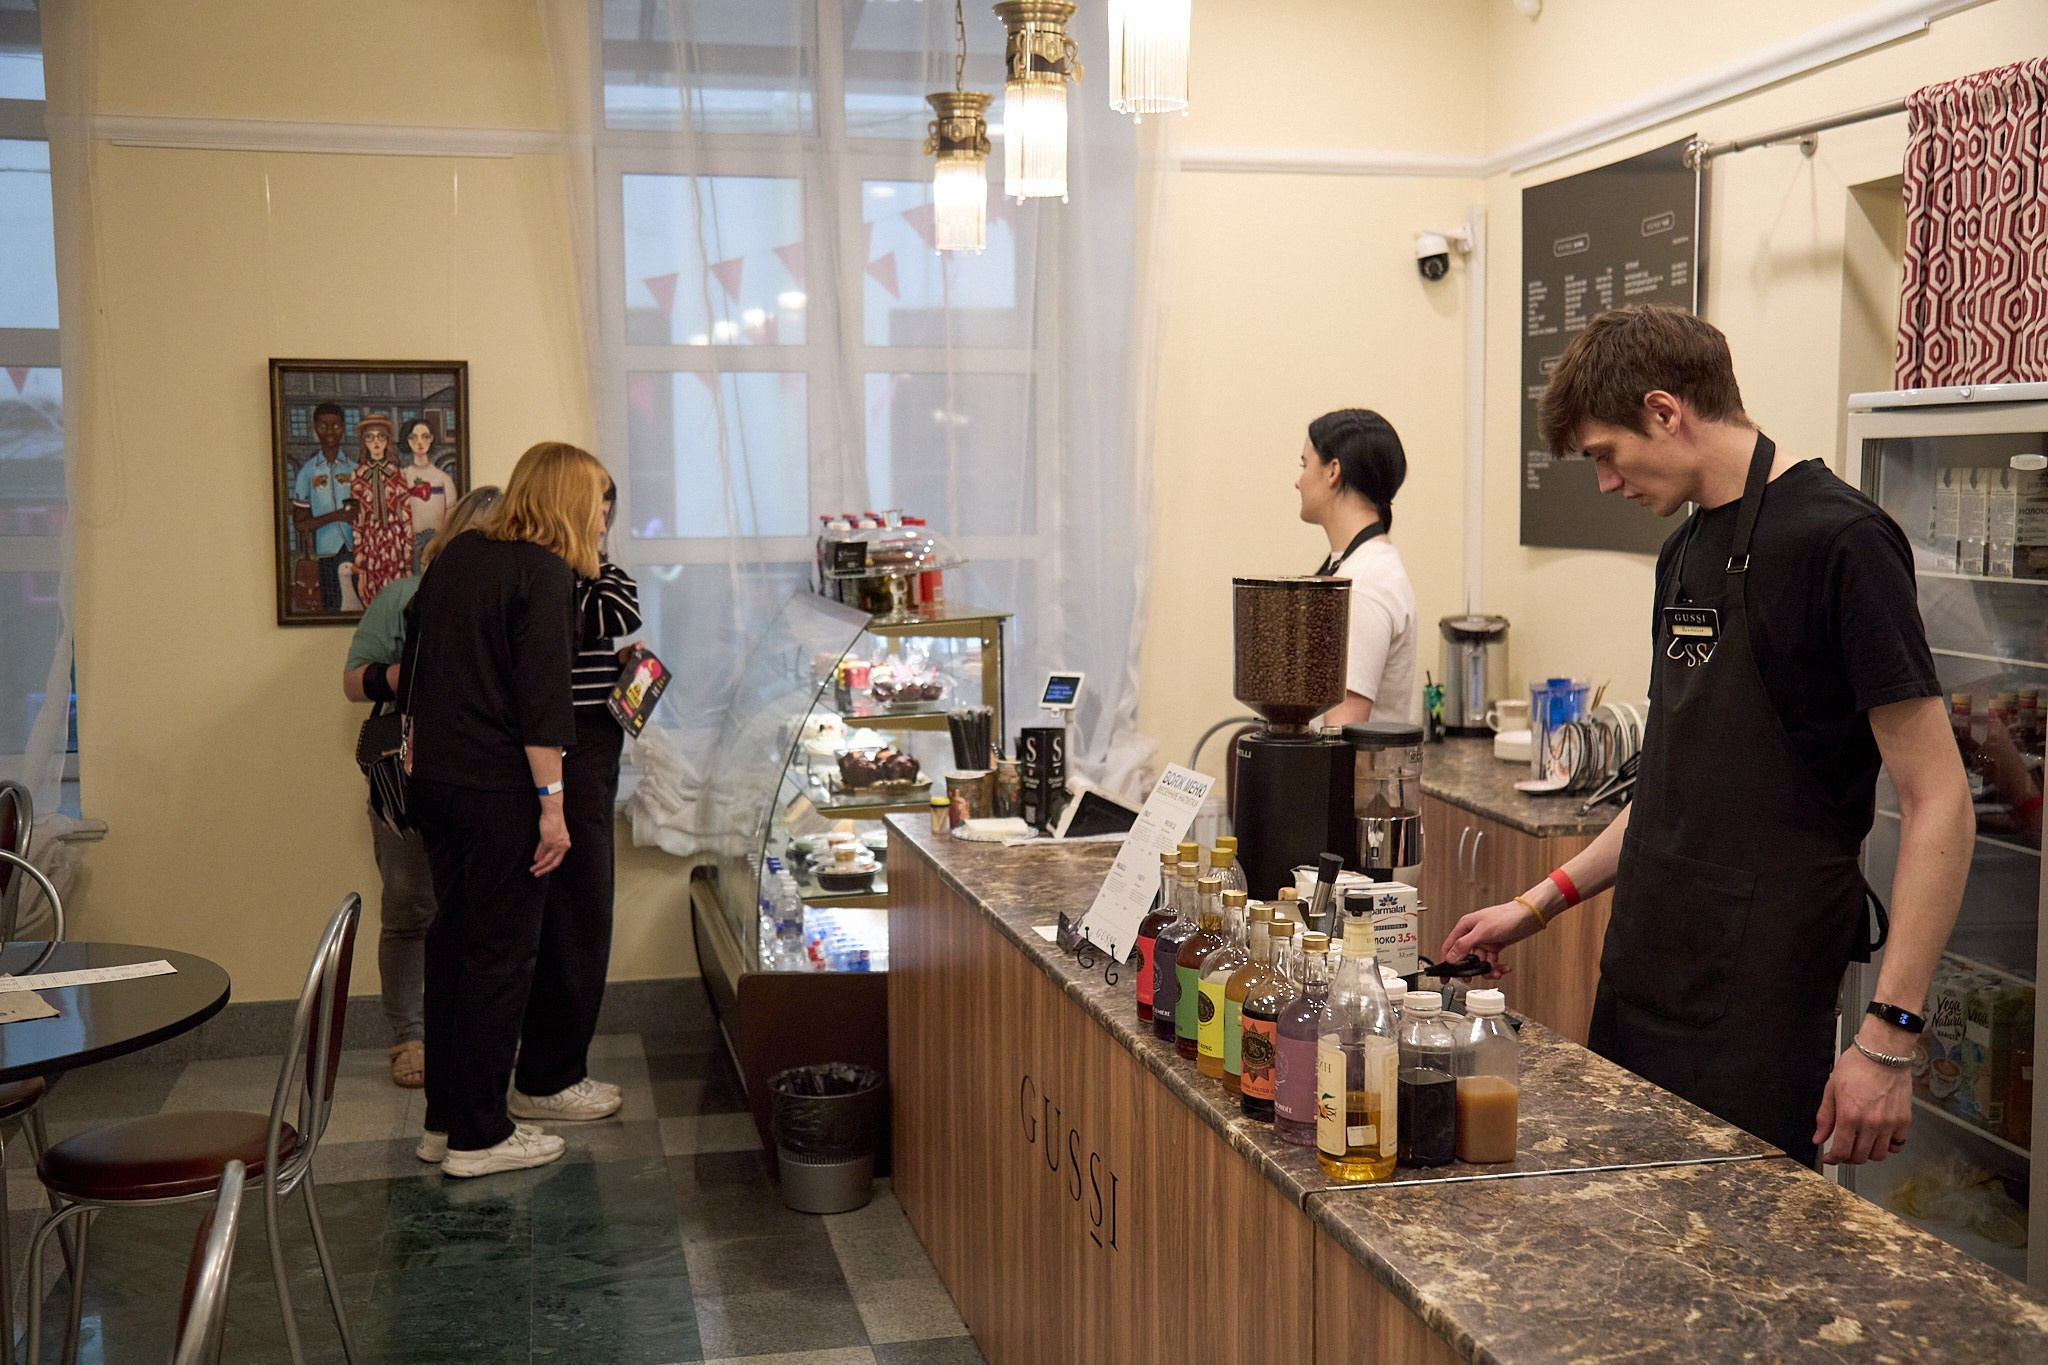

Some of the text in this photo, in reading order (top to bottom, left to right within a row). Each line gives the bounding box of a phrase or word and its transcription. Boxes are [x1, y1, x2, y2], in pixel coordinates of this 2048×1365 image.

[1674, 613, 1706, 624] GUSSI
[1183, 778, 1208, 798] МЕНЮ
[1936, 994, 1961, 1016] Vega
[1021, 1075, 1118, 1252] GUSSI
